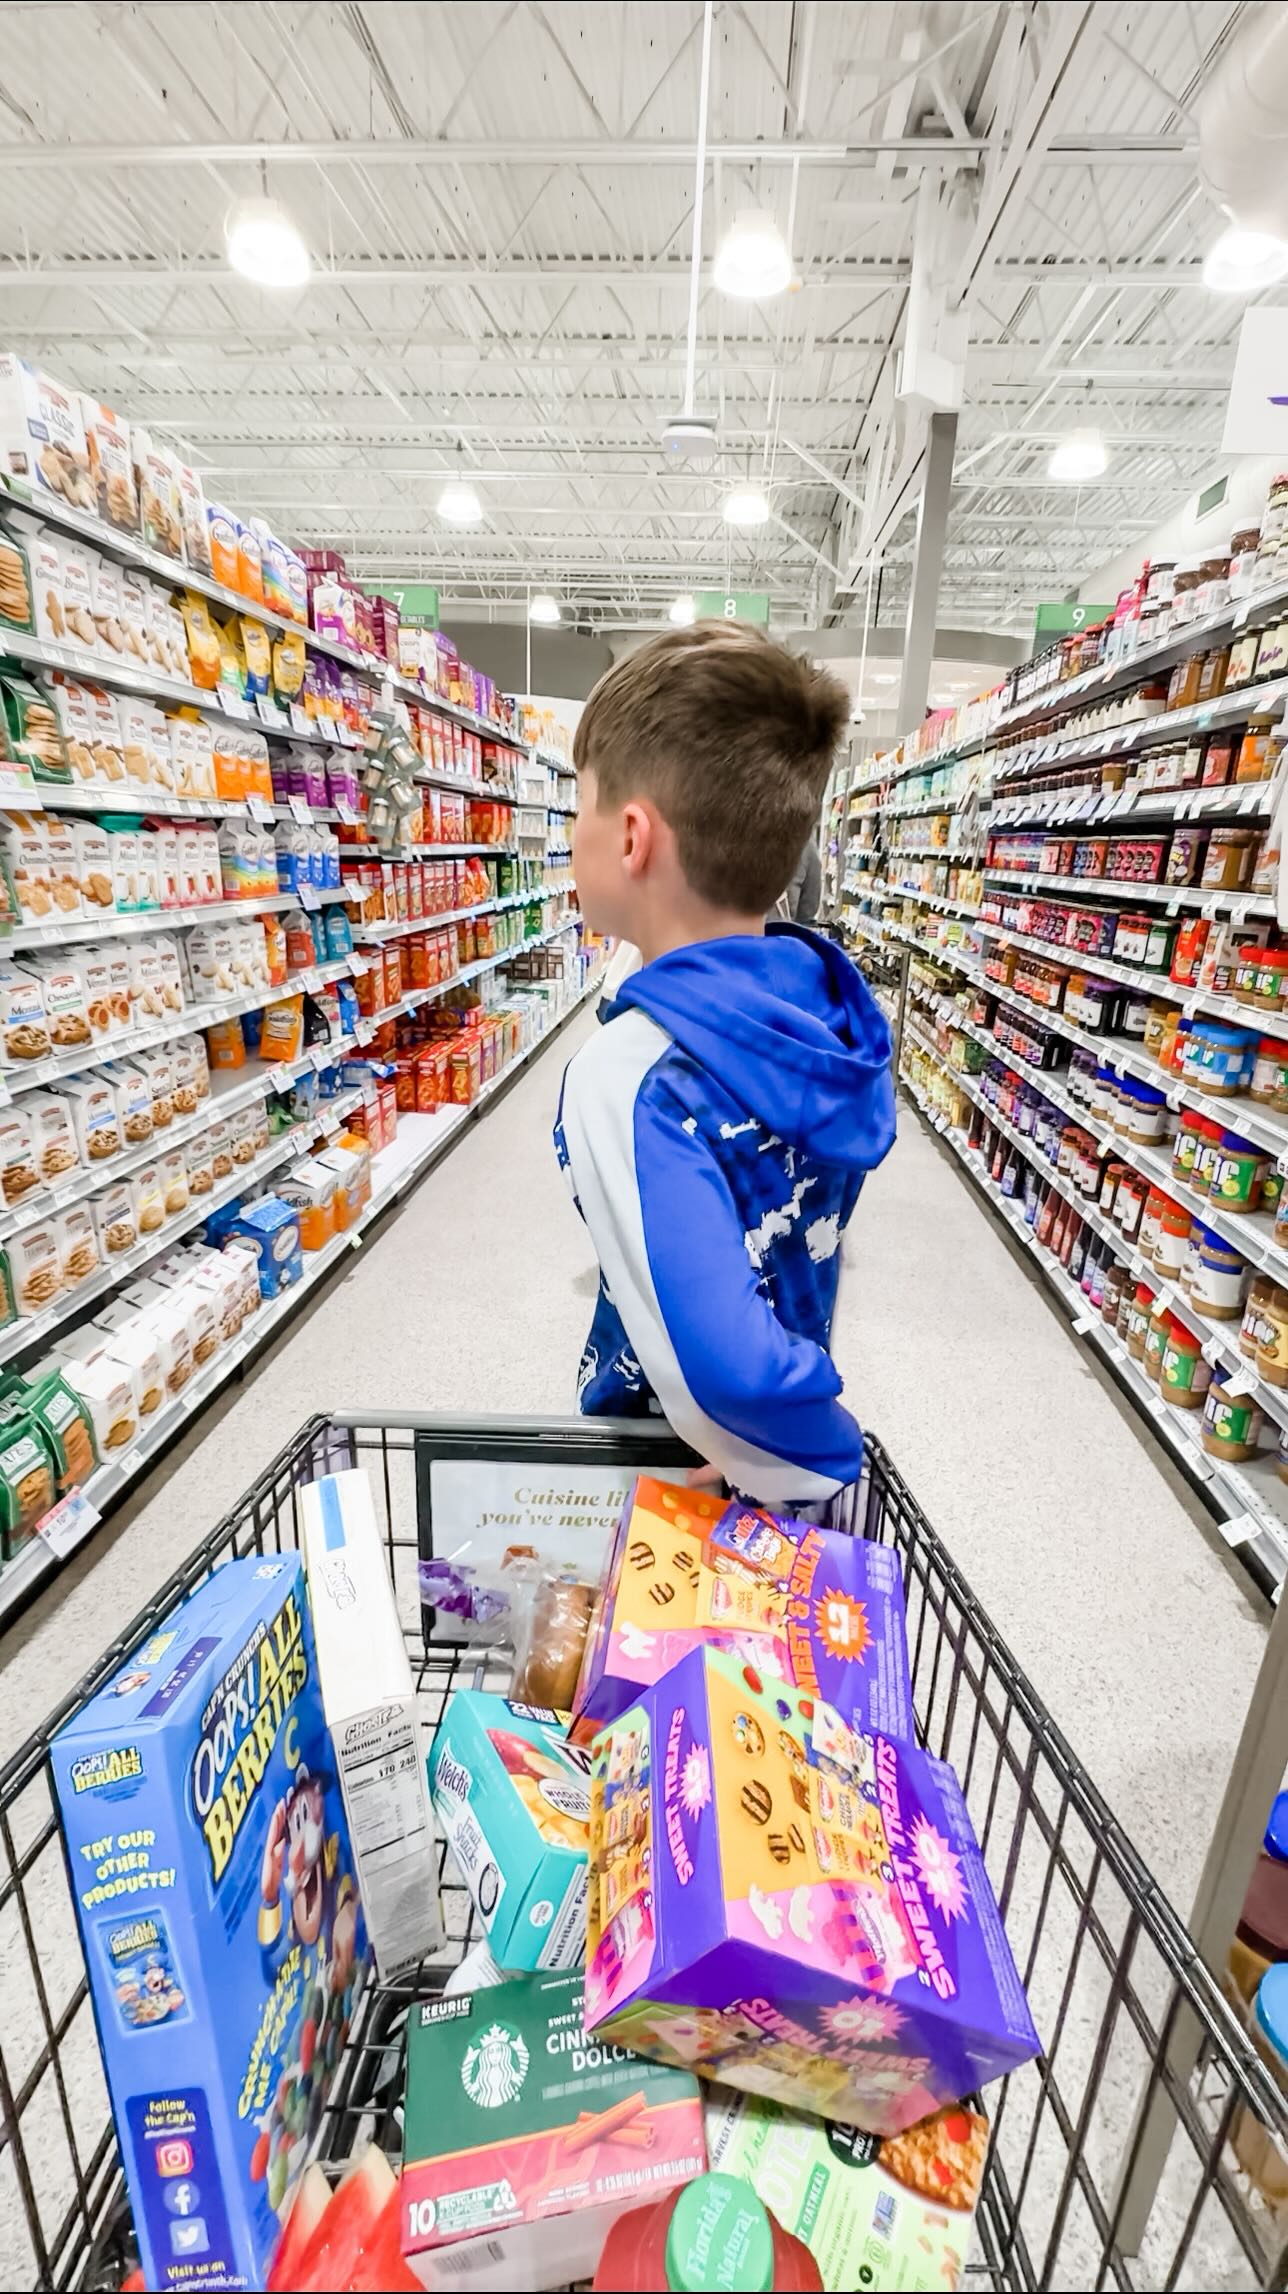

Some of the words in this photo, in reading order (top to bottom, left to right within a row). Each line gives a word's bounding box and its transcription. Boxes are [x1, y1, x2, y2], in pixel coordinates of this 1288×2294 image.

[393, 591, 405, 611] 7
[724, 599, 736, 618] 8
[1072, 608, 1086, 628] 9
[514, 1487, 600, 1507] Cuisine
[476, 1512, 553, 1529] you've
[790, 1529, 827, 1599] SALTY
[788, 1622, 823, 1698] WEET
[193, 1665, 256, 1816] OOPS!
[257, 1595, 304, 1708] ALL
[74, 1761, 143, 1793] BERRIES
[107, 1746, 141, 1773] ALL
[203, 1641, 308, 1882] BERRIES
[436, 1752, 470, 1801] Welch's
[664, 1707, 686, 1803] TREATS
[875, 1735, 905, 1852] TREATS
[80, 1835, 113, 1862] TRY
[117, 1829, 156, 1850] OUR
[664, 1802, 694, 1886] SWEET
[81, 1868, 177, 1911] PRODUCTS!
[96, 1853, 150, 1882] OTHER
[549, 1908, 580, 1968] Nutrition
[891, 1853, 957, 2000] SWEET
[421, 1997, 472, 2020] KEURIG
[711, 2121, 735, 2167] ARVEST
[409, 2198, 436, 2237] 10
[716, 2208, 761, 2292] Natural
